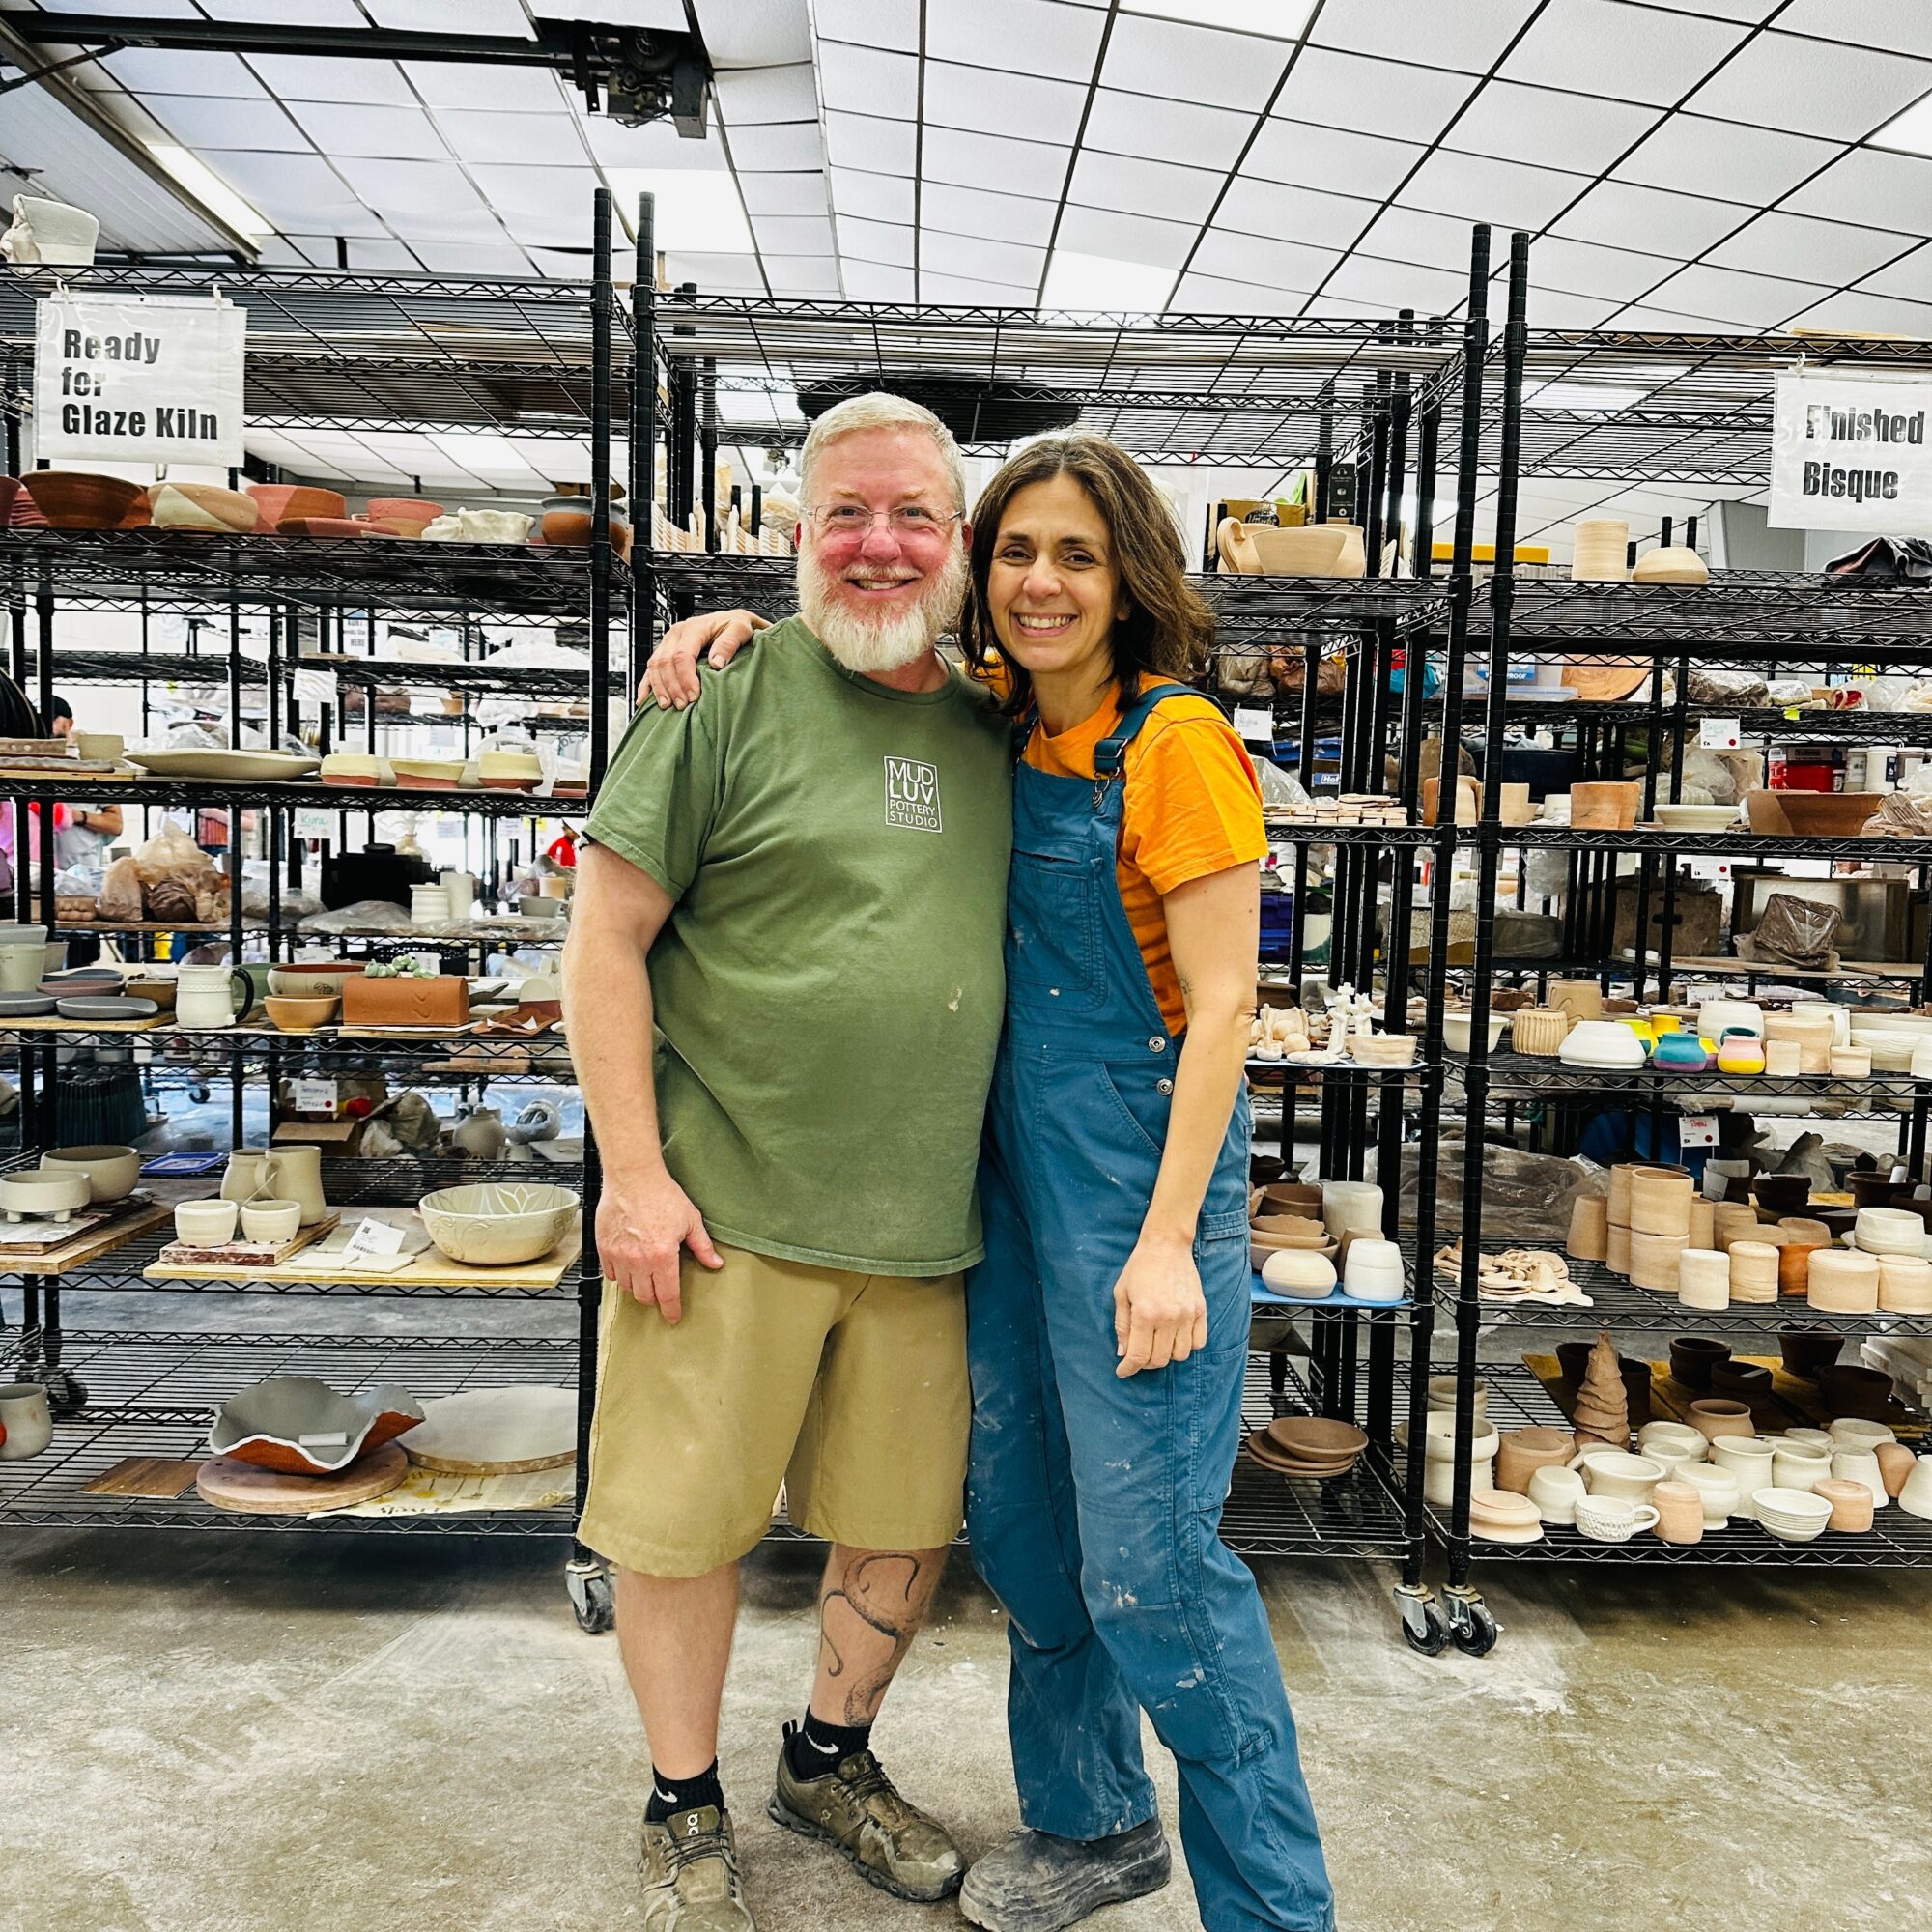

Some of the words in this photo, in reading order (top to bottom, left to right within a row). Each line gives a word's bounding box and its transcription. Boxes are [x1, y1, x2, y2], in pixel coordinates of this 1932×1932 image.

[63, 329, 161, 364] Ready
[61, 366, 107, 397] for
[62, 403, 146, 437] Glaze
[156, 407, 218, 440] Kiln
[1805, 404, 1925, 444] Finished
[1803, 461, 1899, 503] Bisque
[888, 759, 934, 786] MUD
[889, 778, 934, 805] LUV
[889, 799, 936, 816] POTTERY
[889, 810, 938, 828] STUDIO
